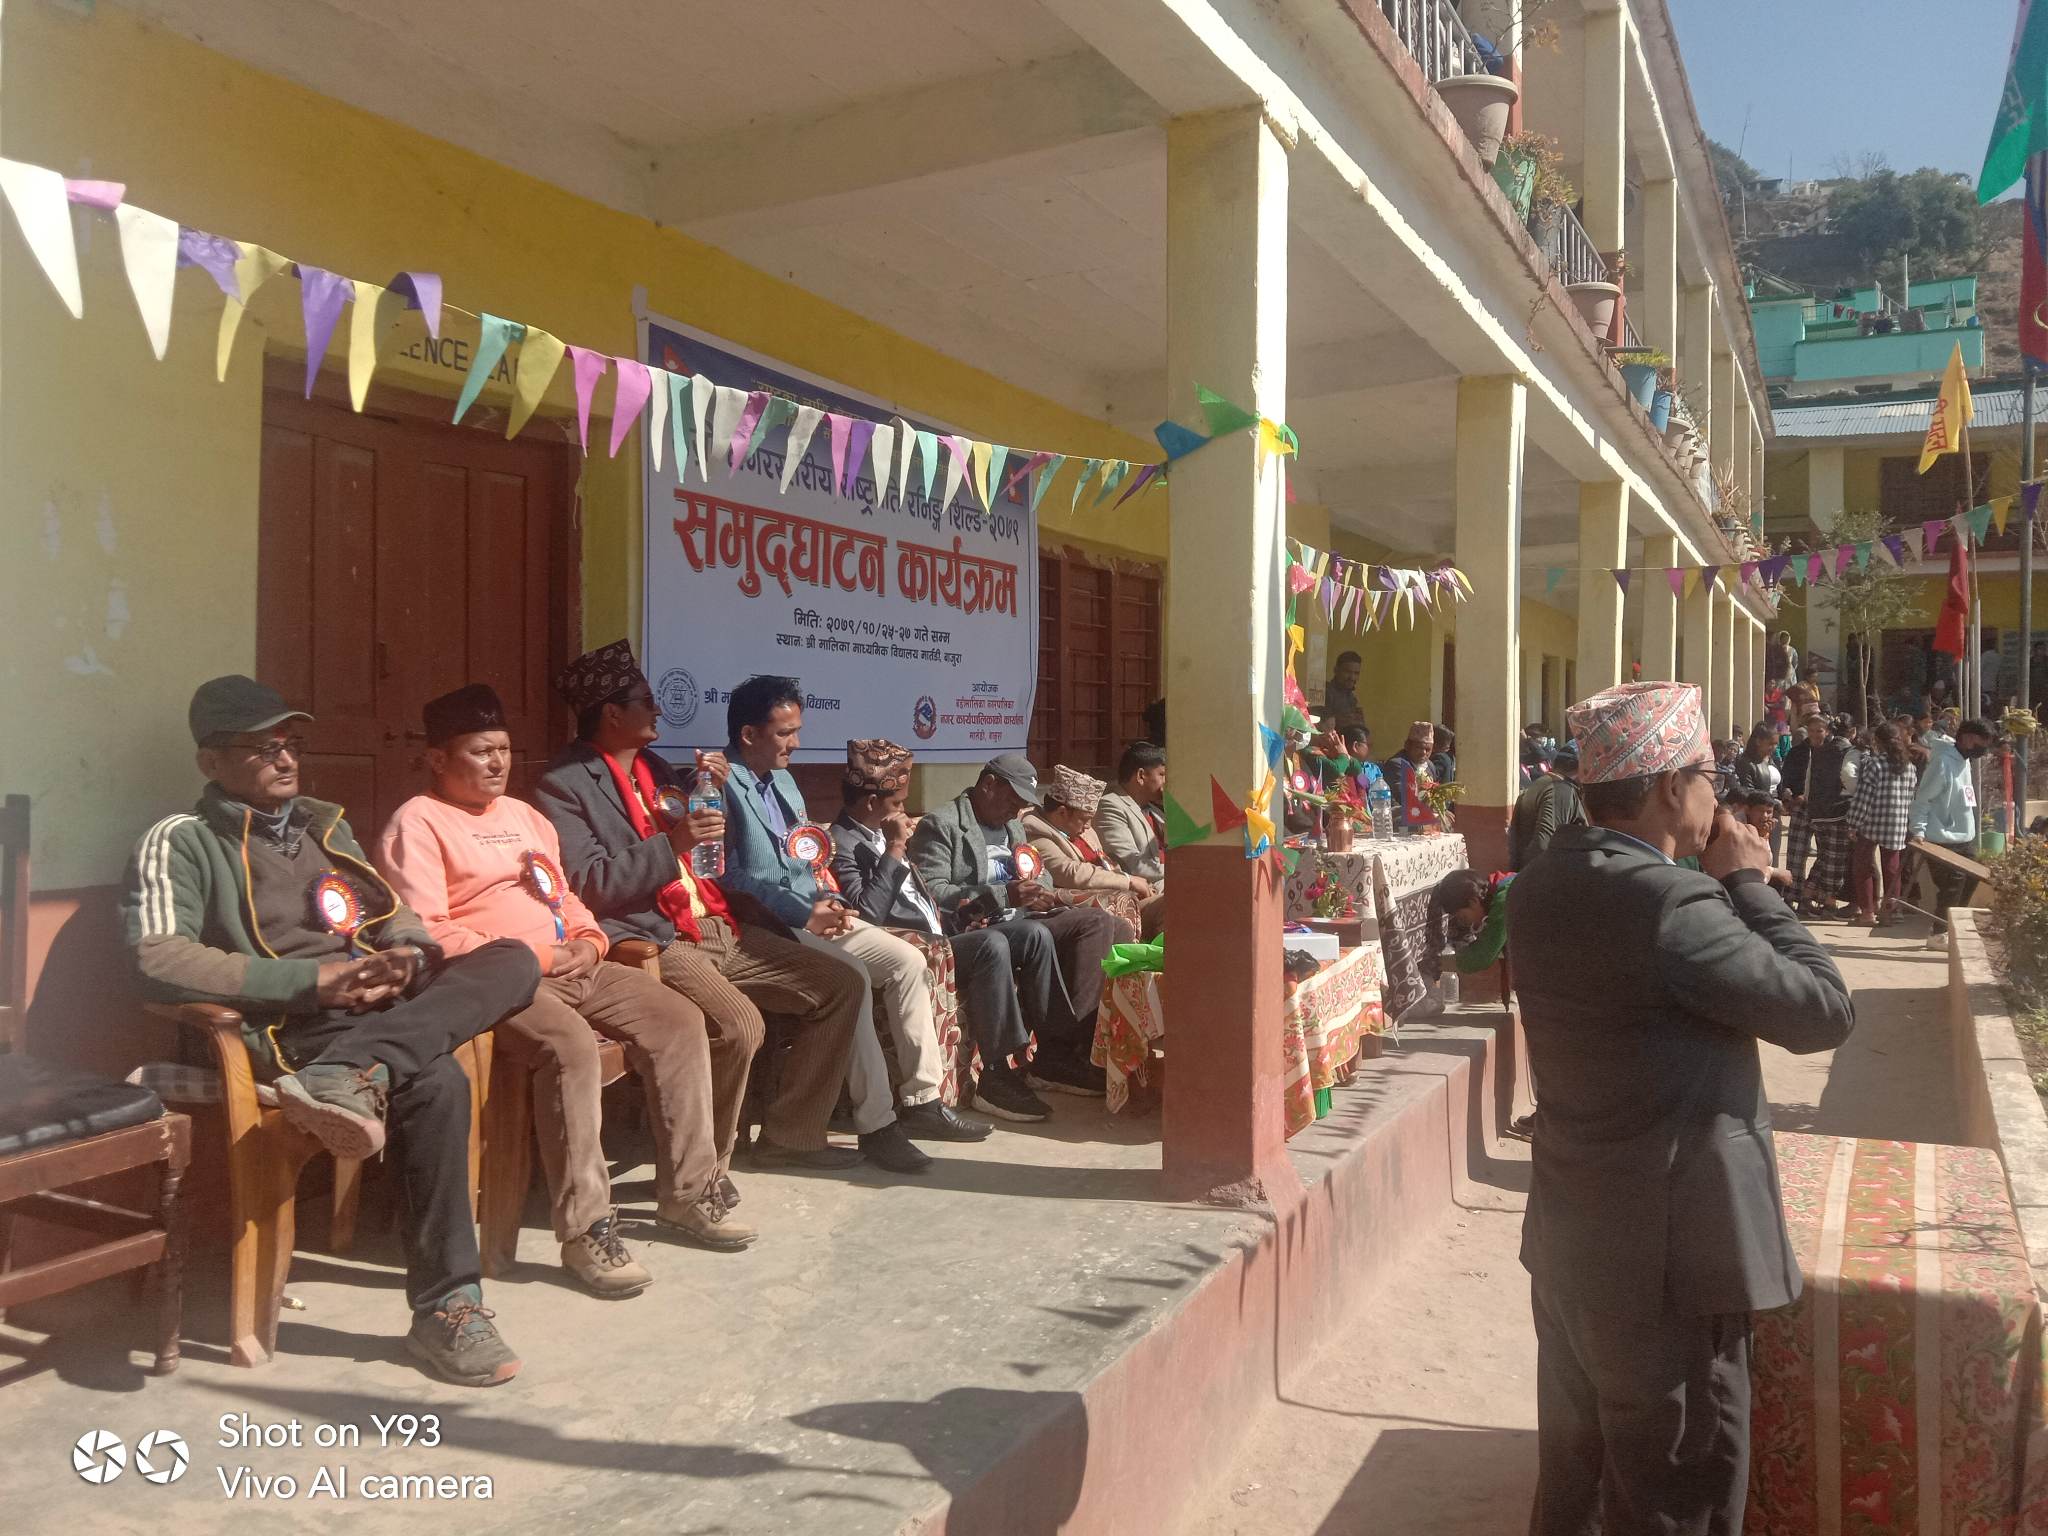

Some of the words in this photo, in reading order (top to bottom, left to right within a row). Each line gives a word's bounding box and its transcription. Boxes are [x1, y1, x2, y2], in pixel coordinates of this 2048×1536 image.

[896, 536, 1018, 618] कार्यक्रम
[914, 625, 929, 643] गते
[931, 631, 950, 645] सम्म
[806, 634, 816, 650] श्री
[819, 637, 850, 653] मालिका
[853, 641, 888, 657] माध्यमिक
[890, 646, 918, 660] विद्यालय
[704, 688, 717, 705] श्री
[972, 681, 999, 693] आयोजक
